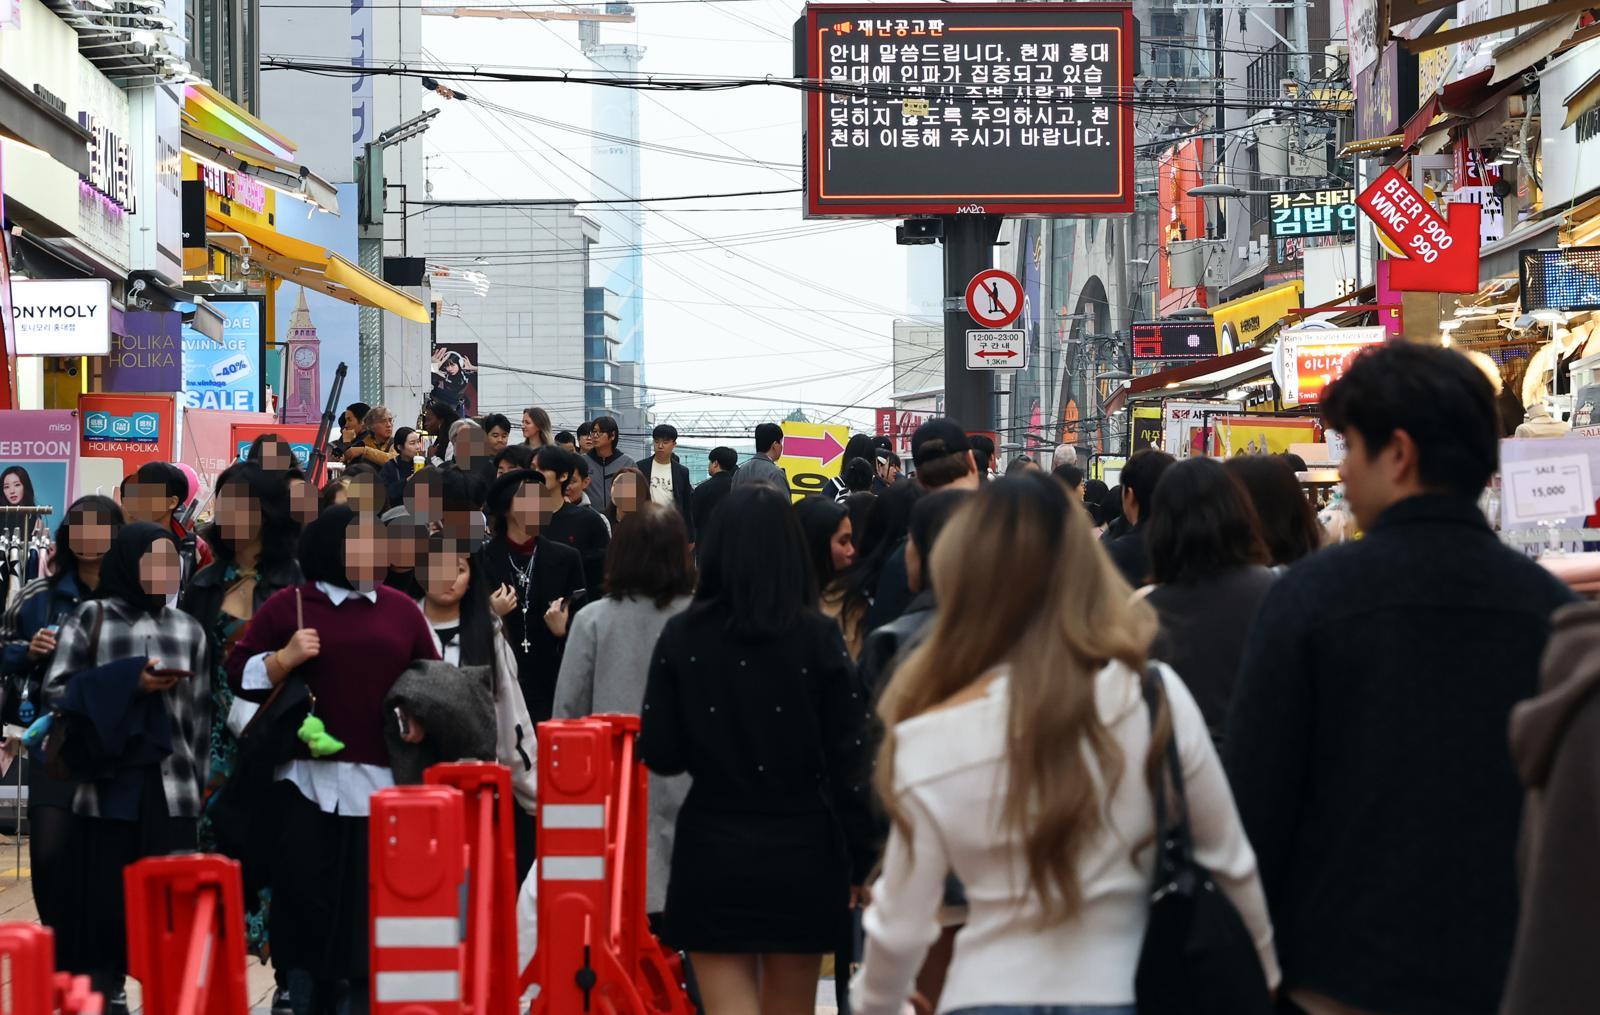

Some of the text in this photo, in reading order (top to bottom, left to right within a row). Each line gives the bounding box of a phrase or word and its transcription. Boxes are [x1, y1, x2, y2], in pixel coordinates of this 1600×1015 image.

[857, 19, 944, 36] 재난공고판
[830, 43, 1109, 63] 안내 말씀드립니다. 현재 홍대
[830, 64, 1102, 84] 일대에 인파가 집중되고 있습
[971, 107, 1082, 126] 주의하시고,
[1092, 106, 1109, 125] 천
[830, 128, 1110, 147] 천히 이동해 주시기 바랍니다.
[1383, 178, 1453, 250] BEER 1900
[1370, 191, 1438, 263] WING 990
[21, 323, 50, 332] 토니모리
[186, 339, 246, 350] VINTAGE
[109, 352, 175, 368] HOLIKA
[186, 389, 251, 410] SALE
[49, 423, 71, 432] miso
[89, 442, 160, 453] HOLIKA HOLIKA
[1535, 465, 1555, 476] SALE
[1532, 485, 1566, 498] 15,000
